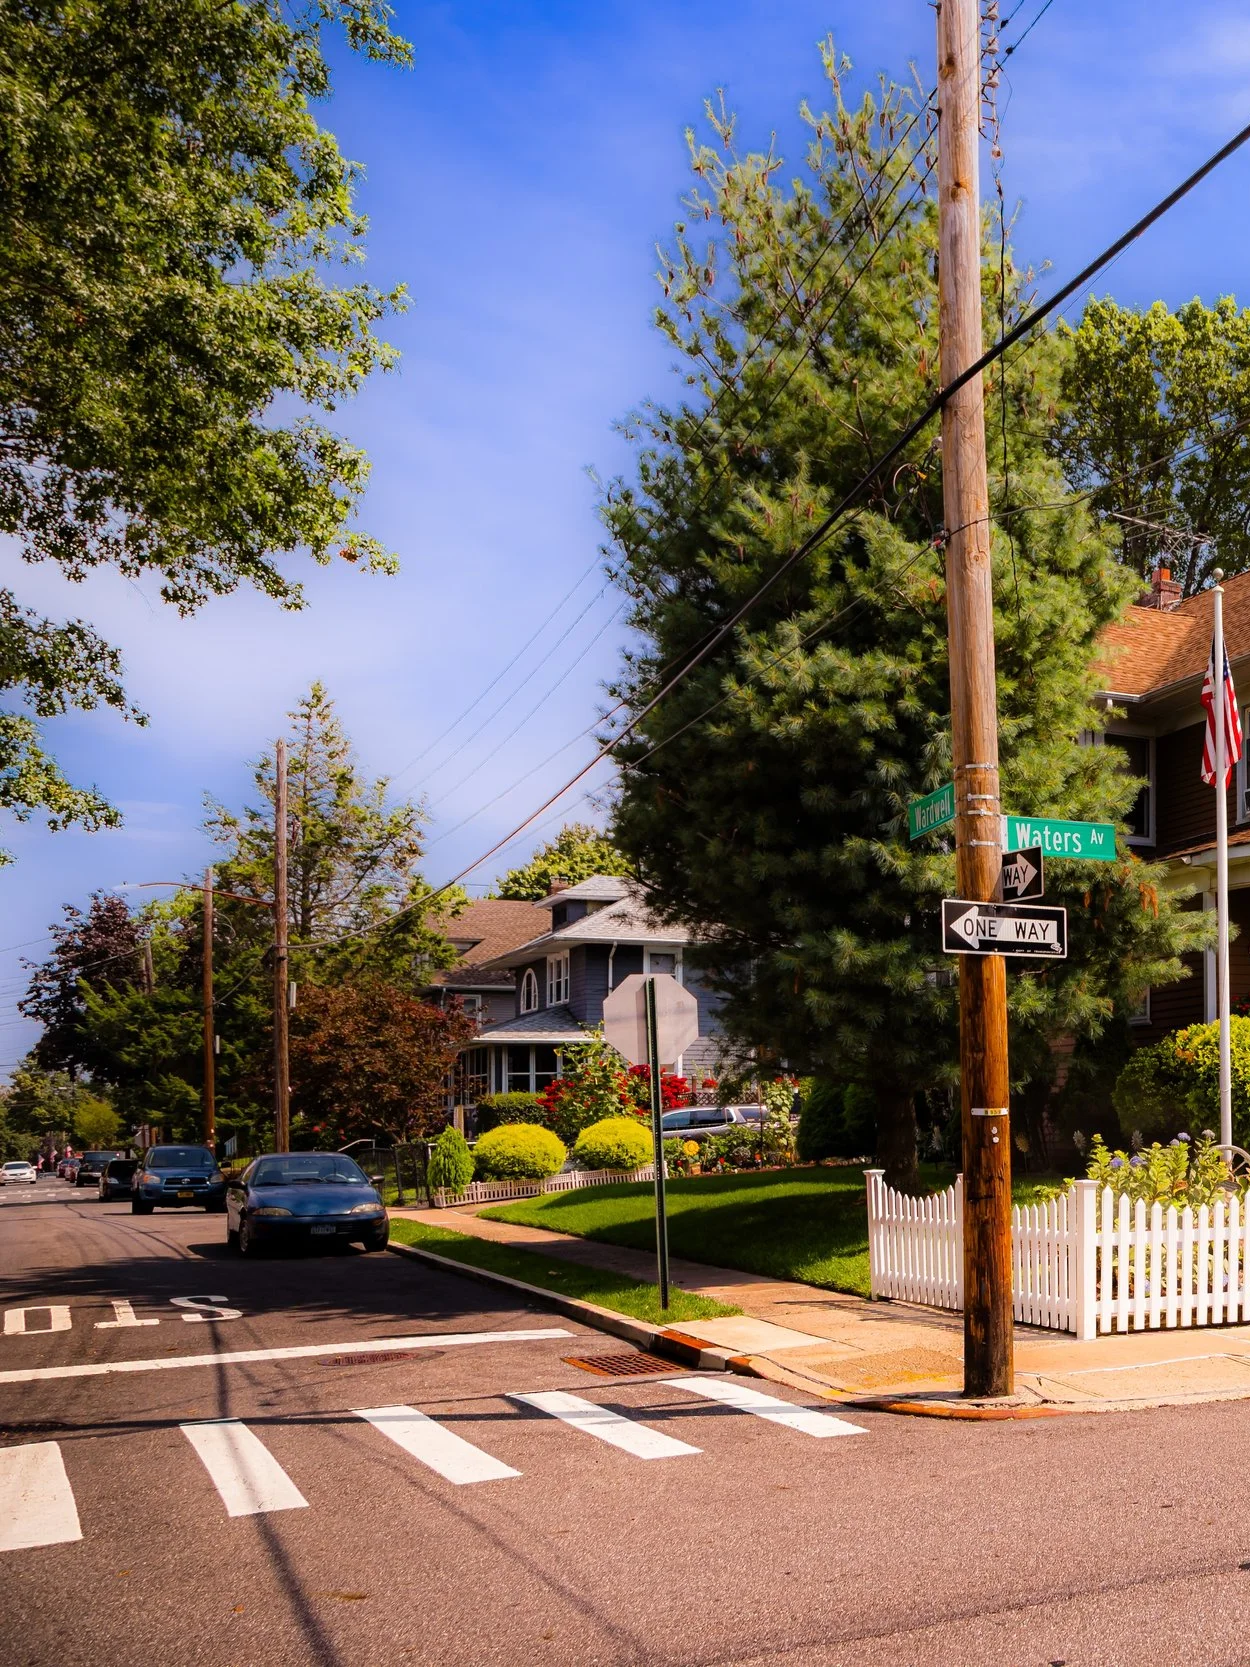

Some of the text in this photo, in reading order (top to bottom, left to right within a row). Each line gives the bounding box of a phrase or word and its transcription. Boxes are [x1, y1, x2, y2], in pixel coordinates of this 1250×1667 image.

[915, 790, 950, 831] Wardwell
[1015, 822, 1104, 853] Waters Av
[1003, 864, 1028, 887] WAY
[963, 918, 1049, 941] ONE WAY
